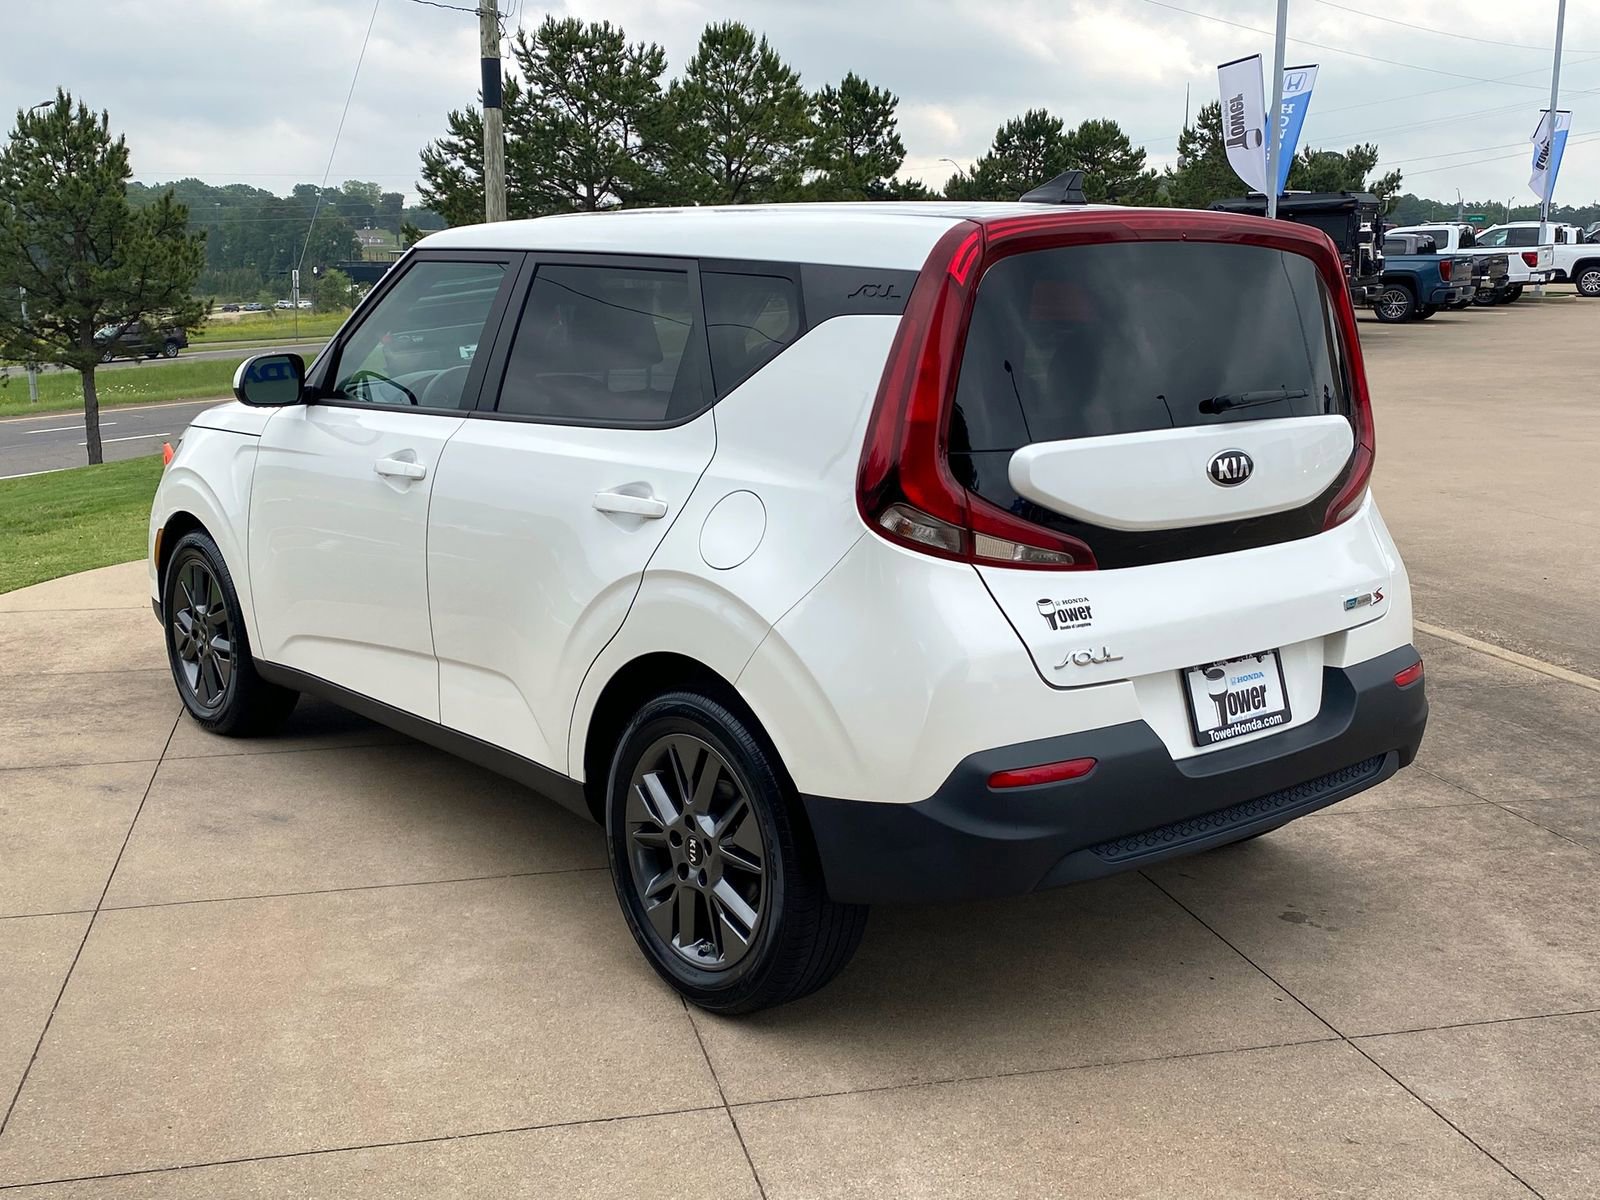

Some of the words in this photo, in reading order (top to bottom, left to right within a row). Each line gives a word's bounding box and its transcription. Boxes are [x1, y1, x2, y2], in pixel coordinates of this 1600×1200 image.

[1216, 456, 1250, 480] KIA
[1061, 597, 1090, 606] HONDA
[1038, 602, 1093, 630] Tower
[1236, 671, 1265, 684] HONDA
[1208, 683, 1267, 726] Tower
[1208, 713, 1284, 742] TowerHonda.com
[689, 839, 697, 862] KIA
